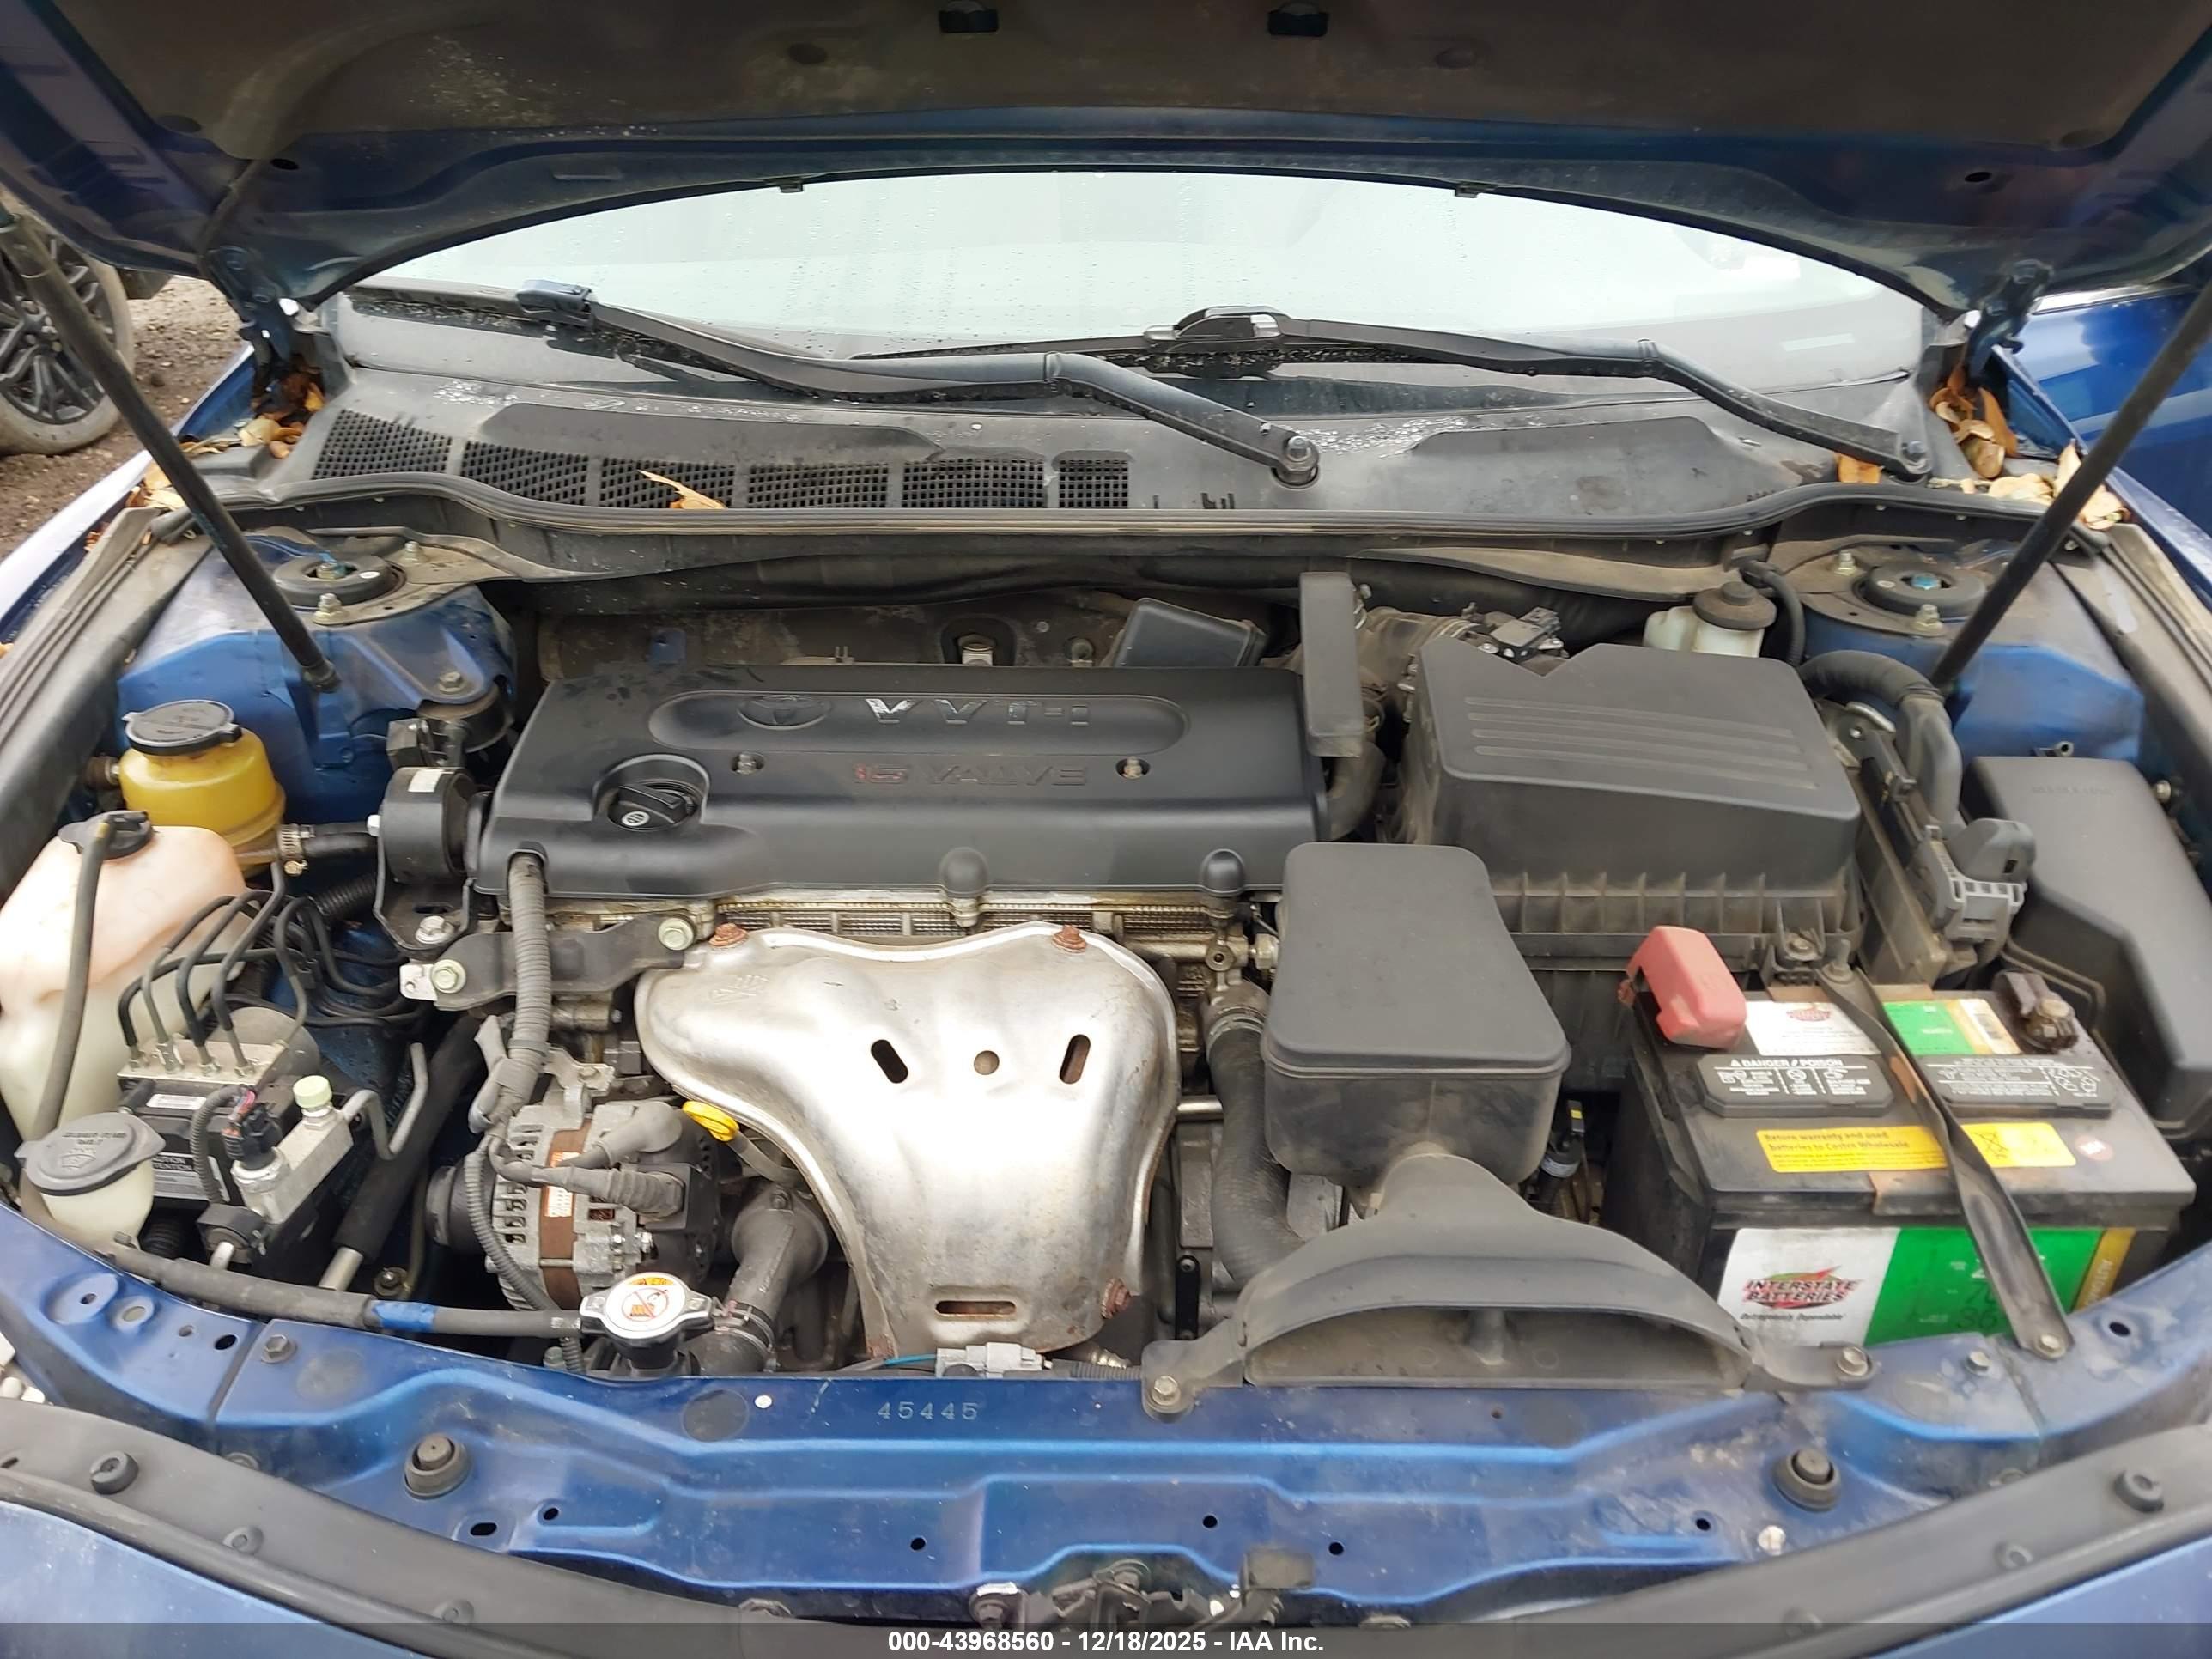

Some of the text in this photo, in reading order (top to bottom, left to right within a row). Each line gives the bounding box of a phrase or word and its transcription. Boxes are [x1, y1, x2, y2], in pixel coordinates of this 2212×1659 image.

[929, 764, 1087, 786] VALVE
[1746, 1280, 1858, 1291] INTERSTATE
[1746, 1291, 1845, 1302] BATTERIES
[877, 1401, 978, 1420] 45445
